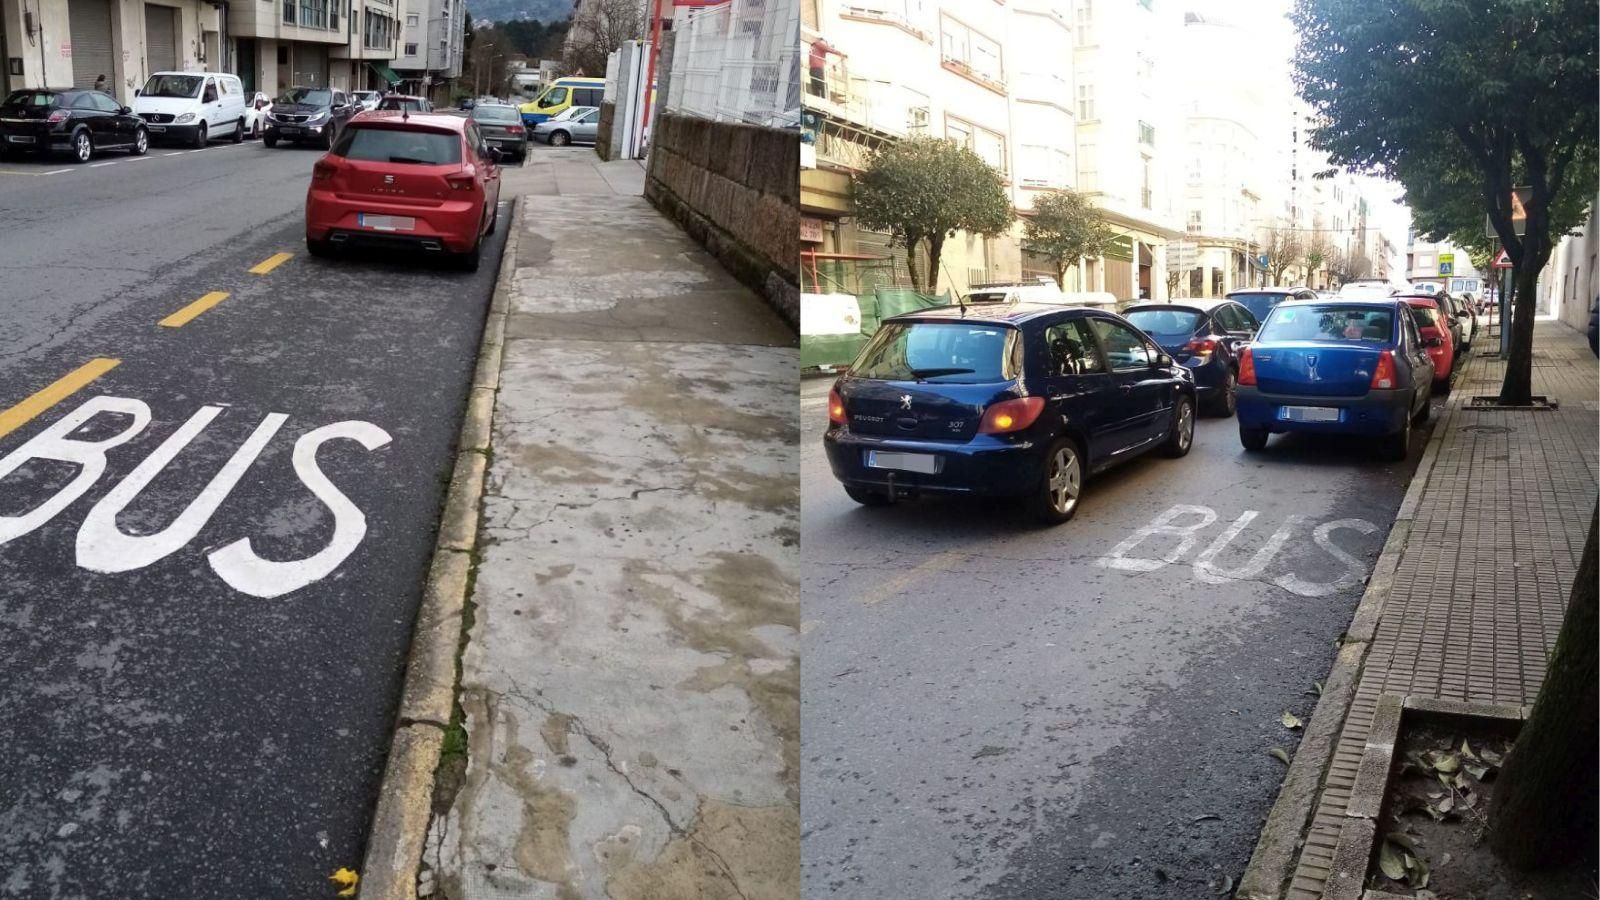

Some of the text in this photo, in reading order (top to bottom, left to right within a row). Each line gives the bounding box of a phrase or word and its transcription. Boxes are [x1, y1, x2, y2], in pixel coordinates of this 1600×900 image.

[853, 414, 884, 423] PEUGEOT
[0, 396, 393, 598] BUS
[1095, 504, 1380, 597] BUS
